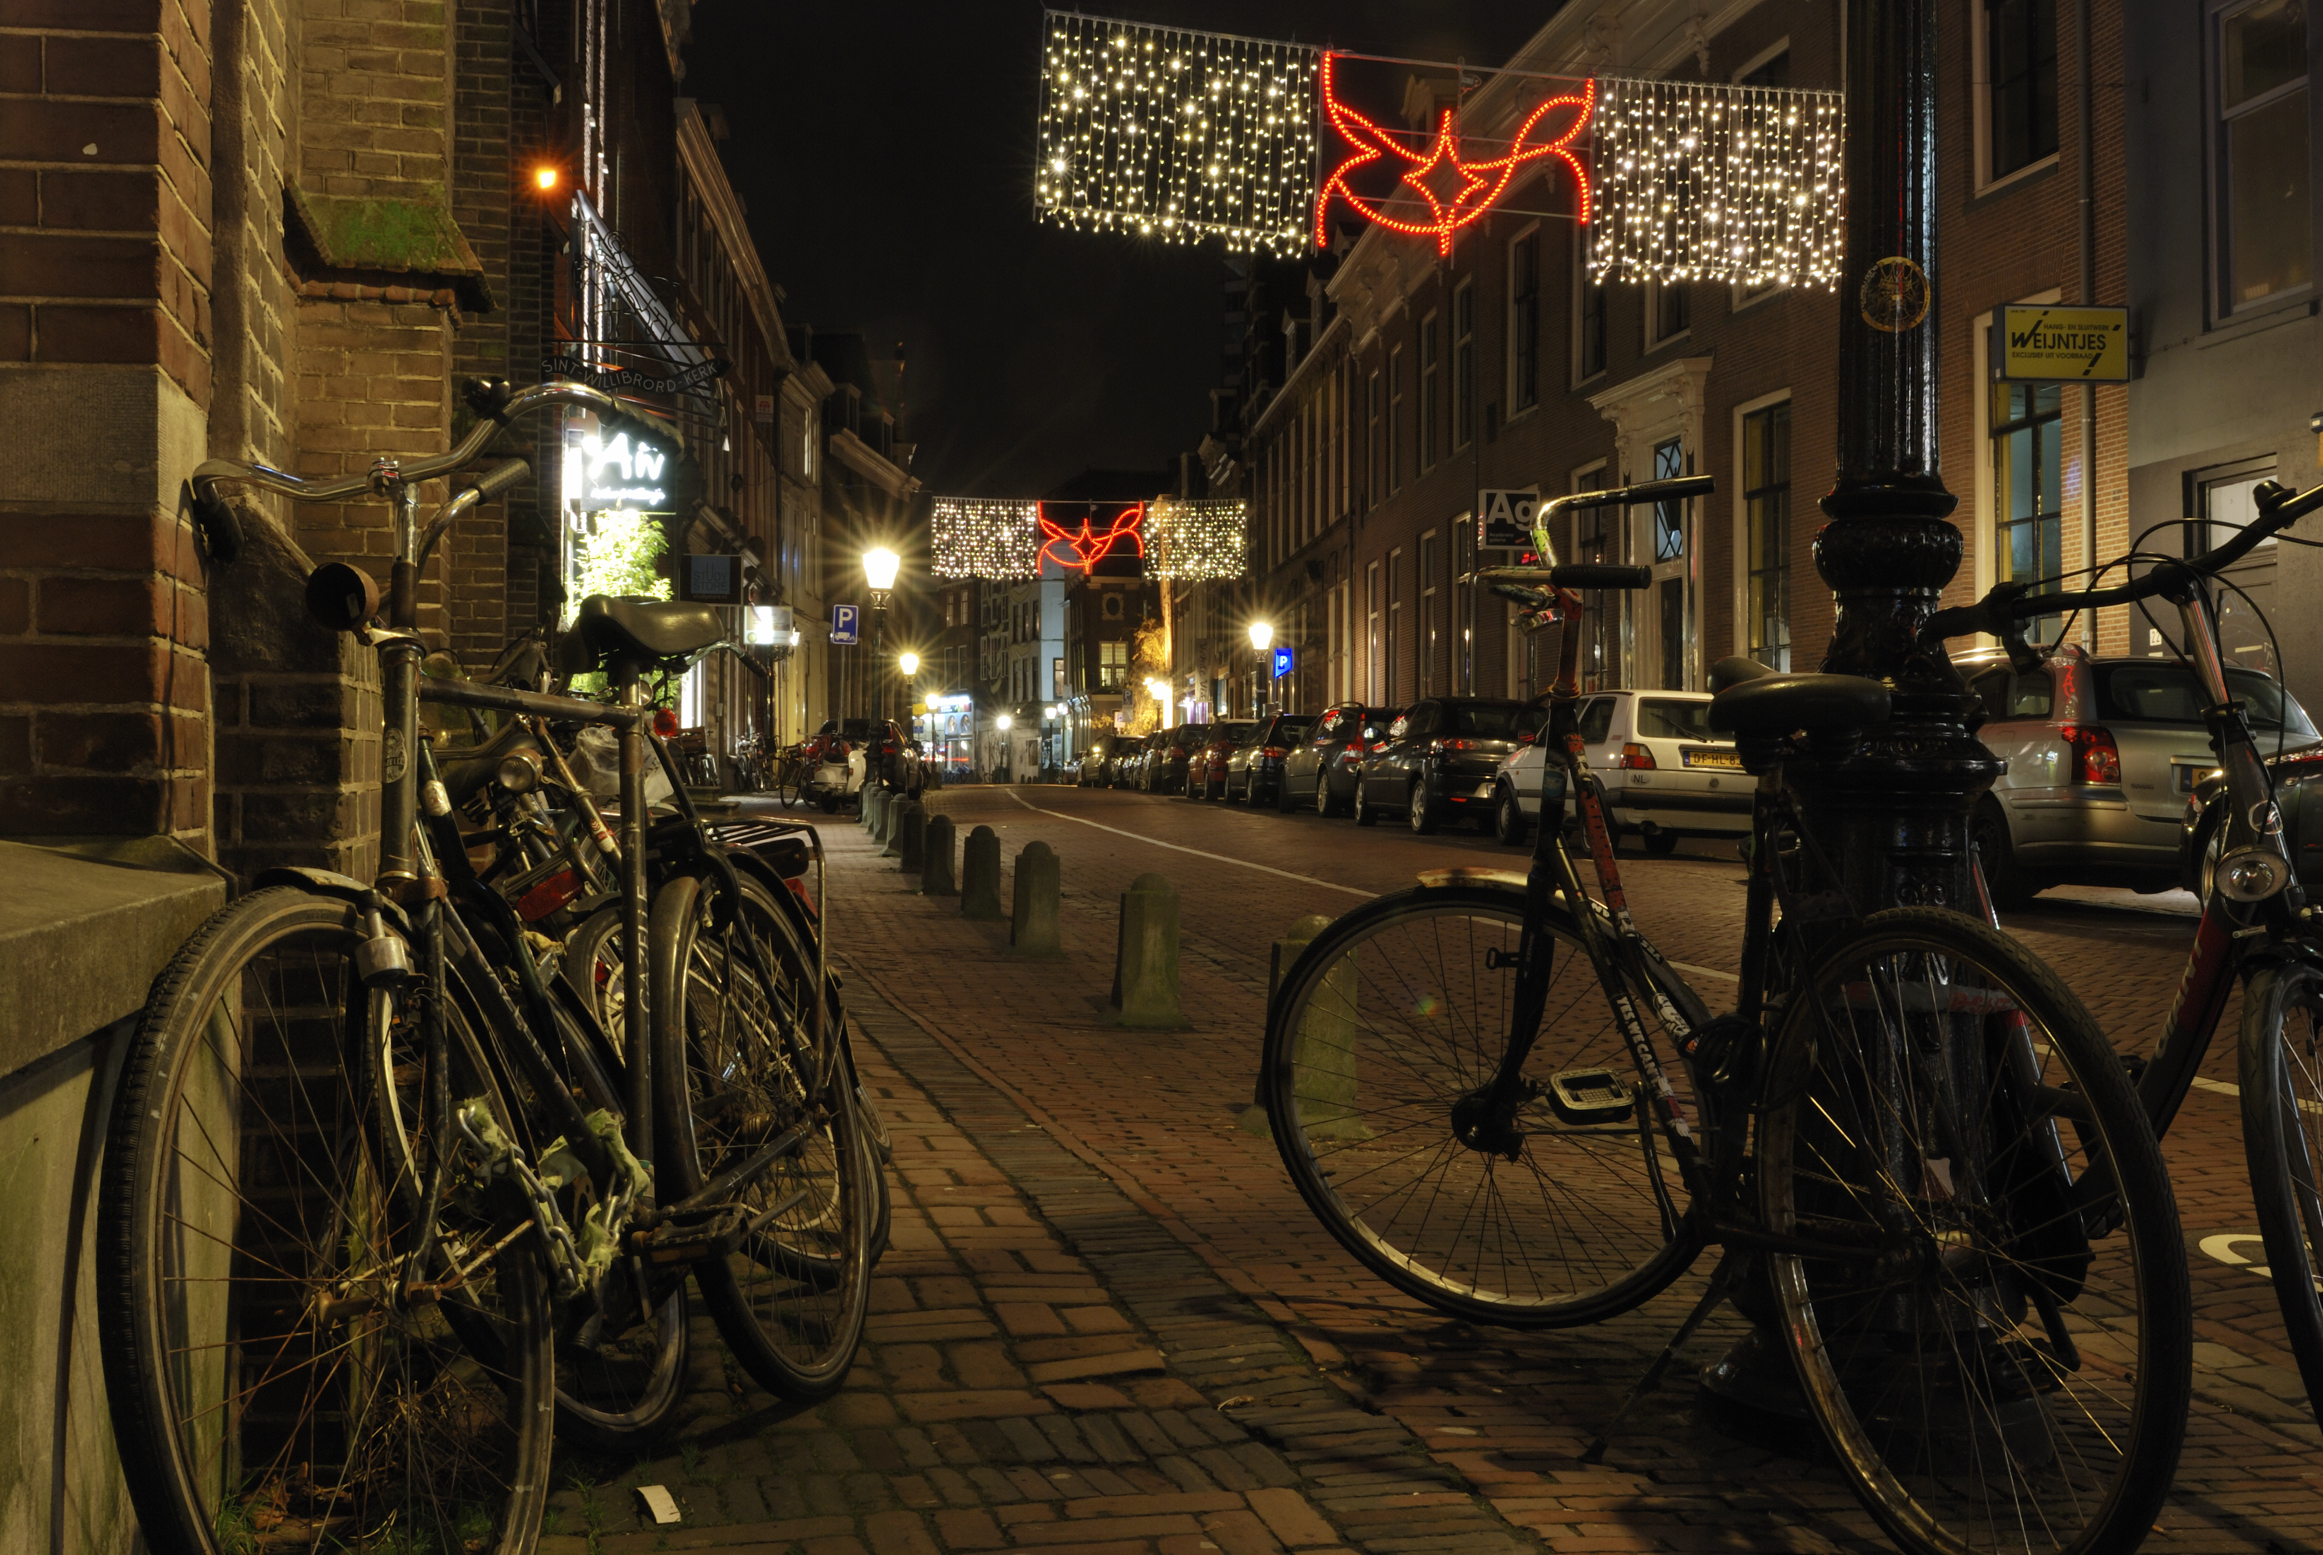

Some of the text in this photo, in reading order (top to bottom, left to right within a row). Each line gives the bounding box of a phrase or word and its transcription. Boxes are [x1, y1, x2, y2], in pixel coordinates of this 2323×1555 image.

[2011, 320, 2106, 350] WEIJNTJES
[1486, 493, 1537, 532] Ag
[693, 562, 728, 582] STUDY
[693, 581, 728, 591] STORE
[838, 608, 853, 628] P
[1279, 655, 1288, 667] P
[1633, 775, 1646, 783] NL
[1627, 1020, 1646, 1045] WE
